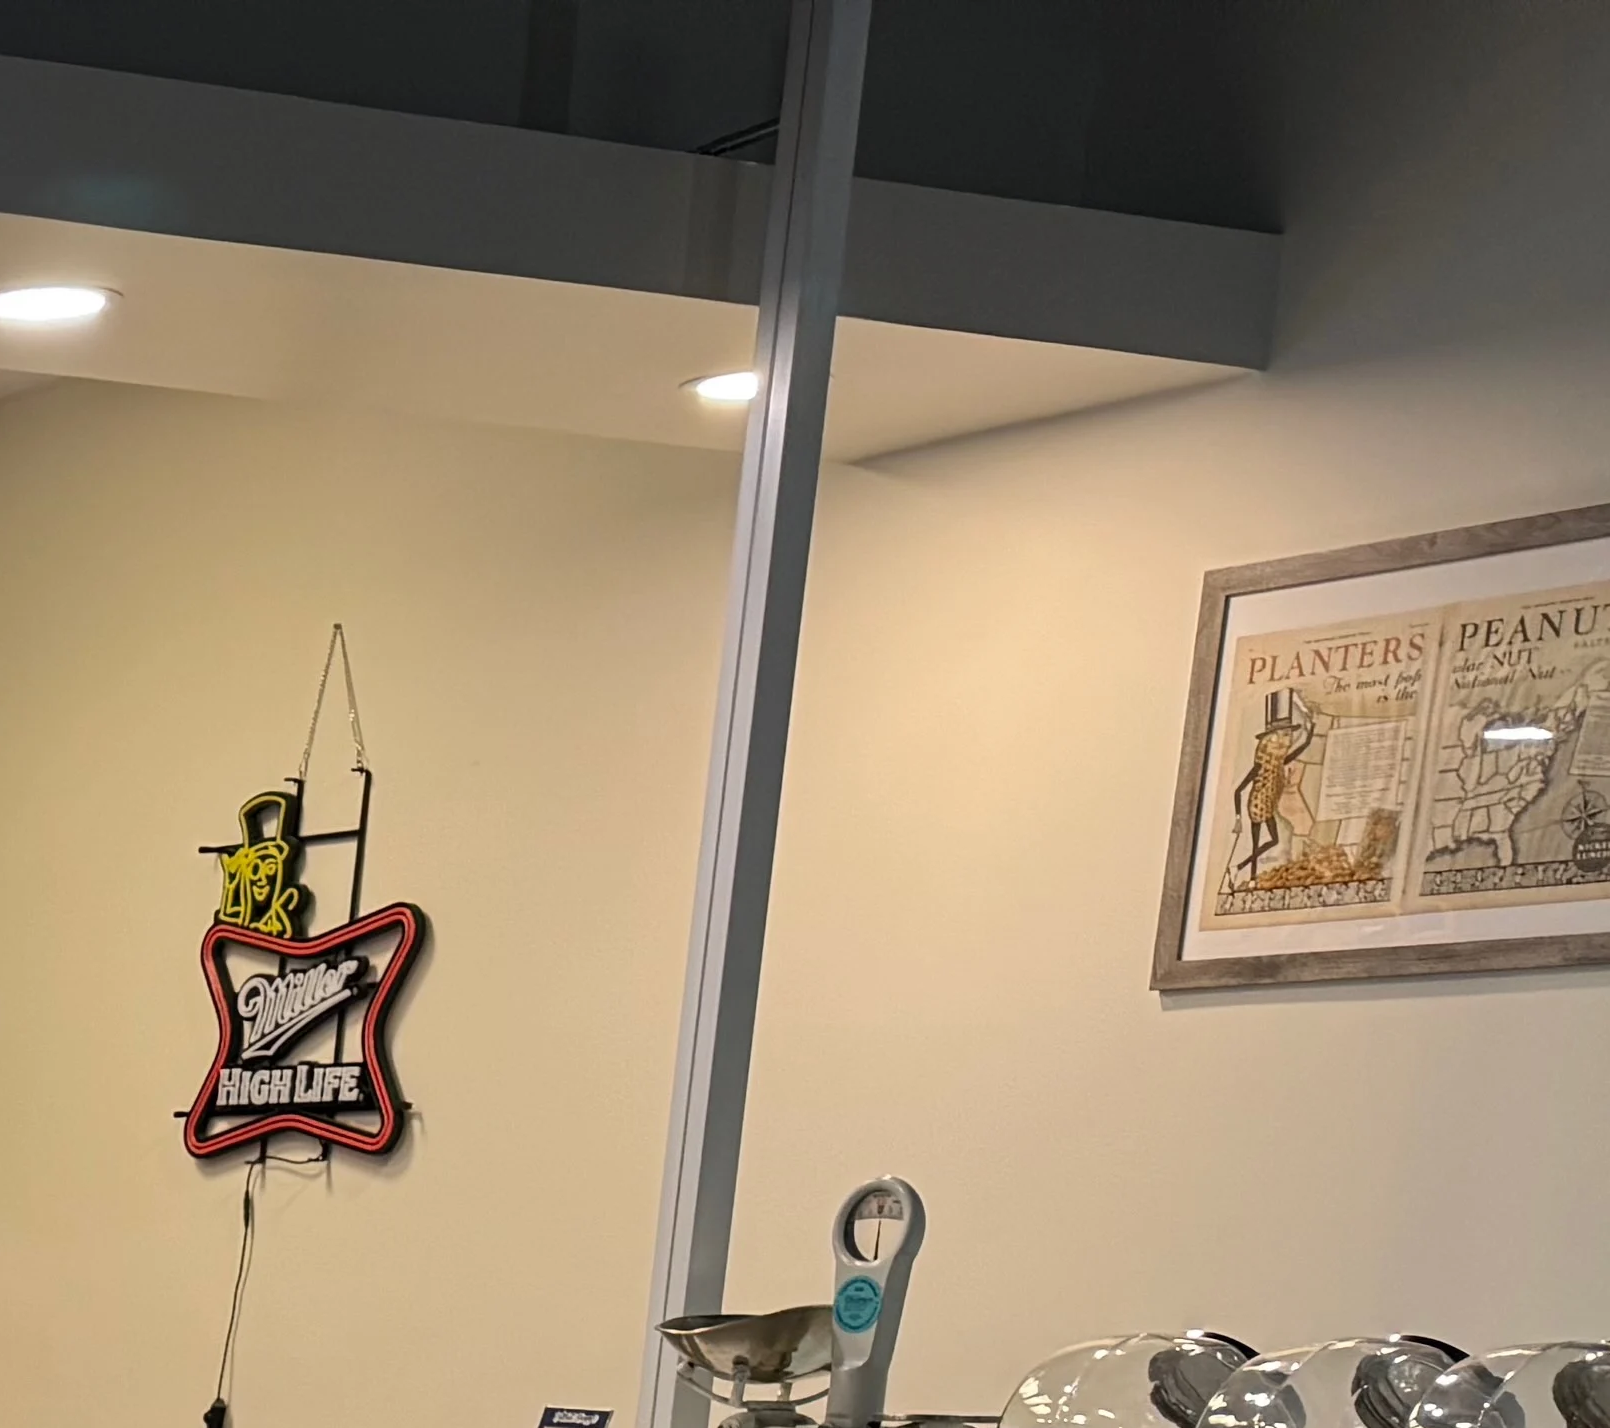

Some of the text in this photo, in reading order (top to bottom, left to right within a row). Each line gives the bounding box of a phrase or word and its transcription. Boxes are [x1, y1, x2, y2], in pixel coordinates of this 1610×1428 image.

[1247, 633, 1424, 685] PLANTERS
[1491, 646, 1536, 668] NUT
[1324, 676, 1350, 696] The
[1395, 690, 1418, 701] the
[238, 961, 357, 1043] Miller
[217, 1065, 358, 1105] HIGH LIFE
